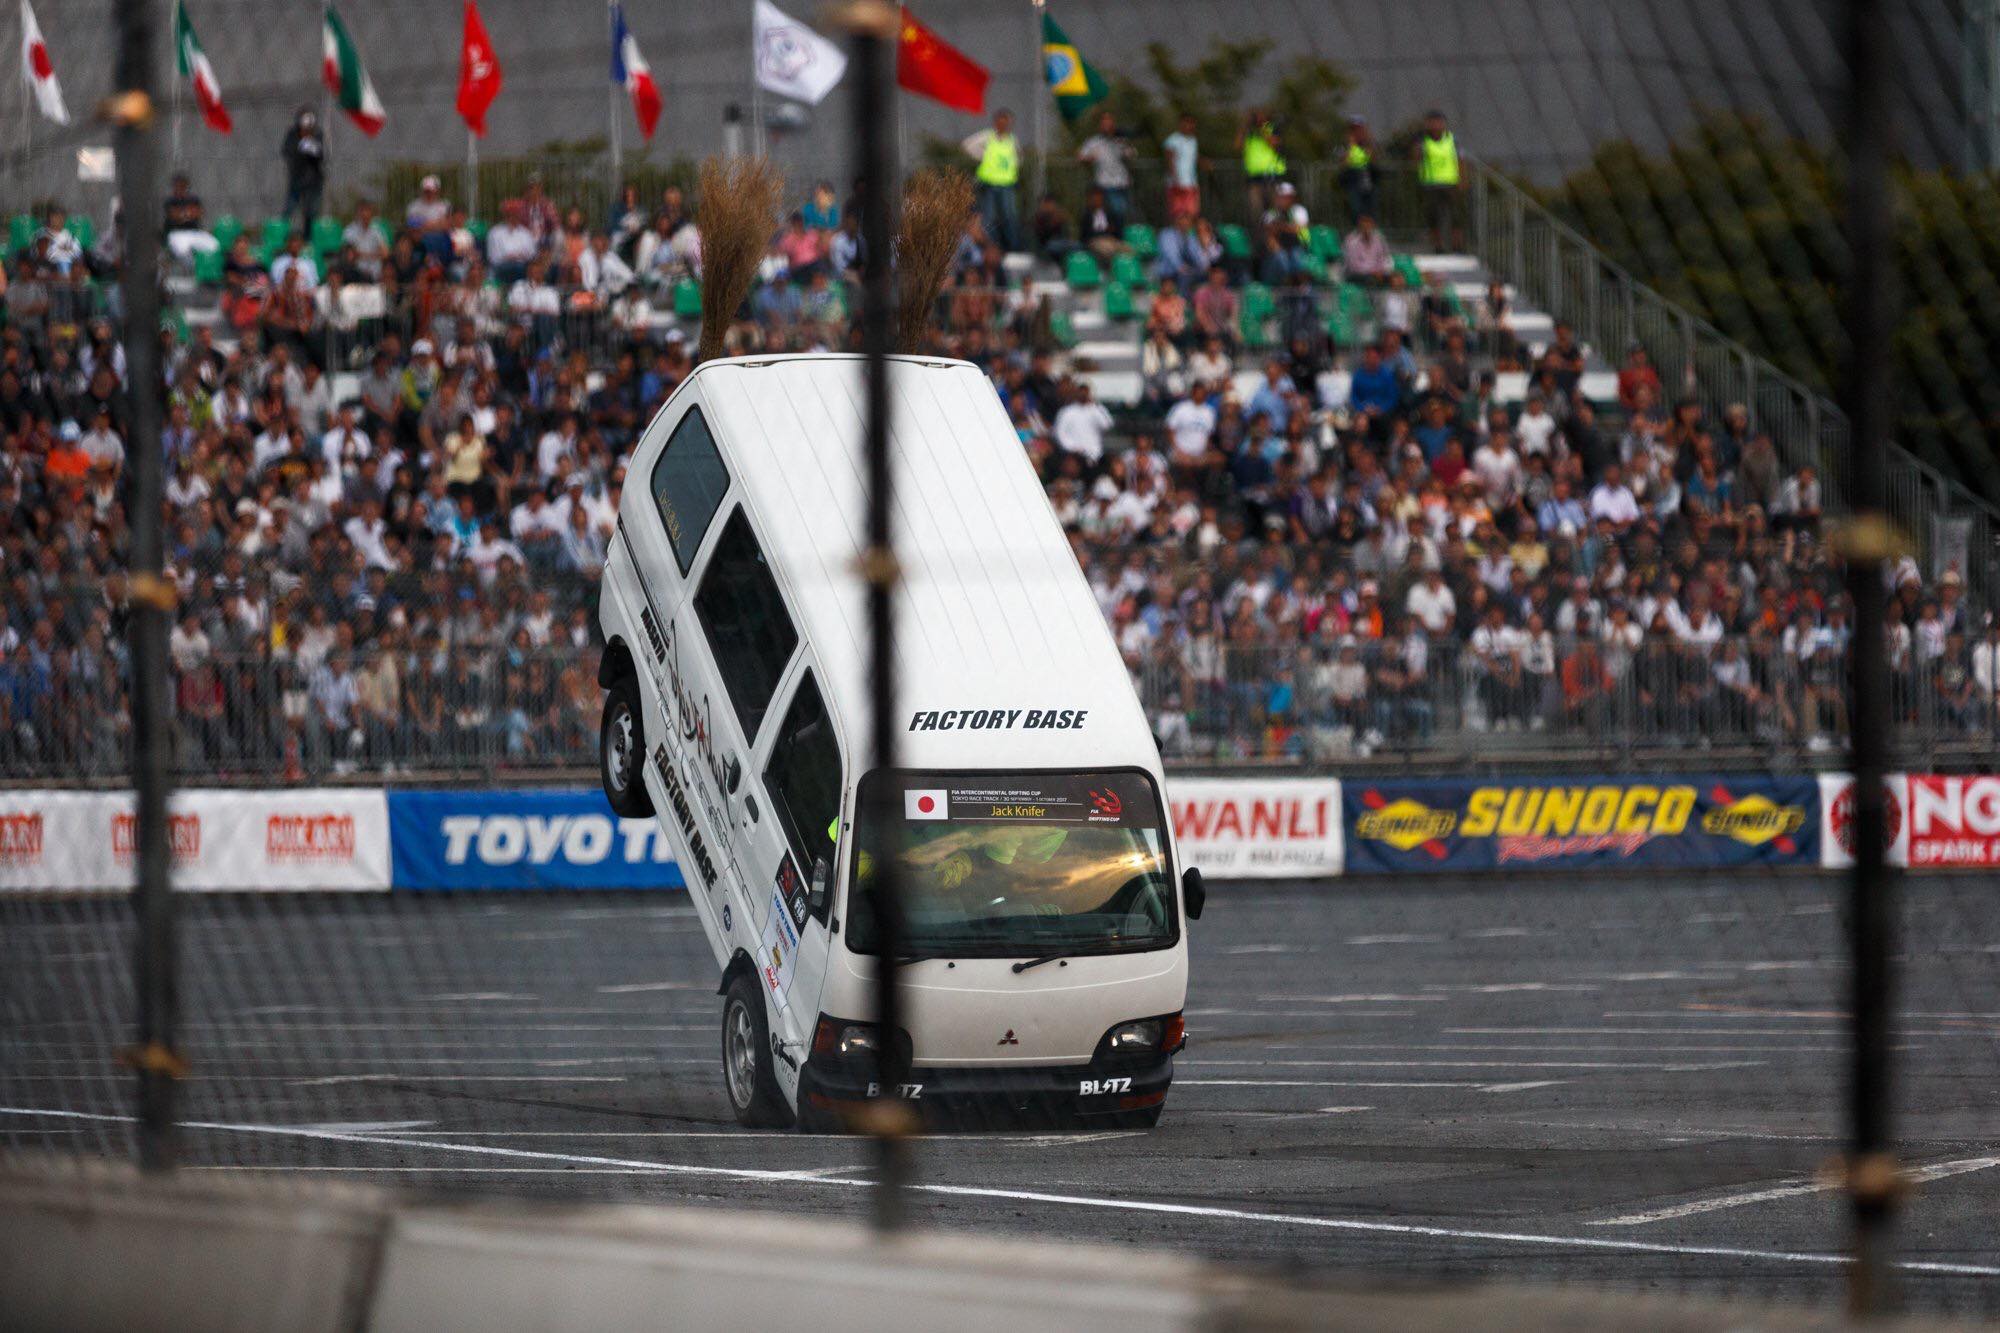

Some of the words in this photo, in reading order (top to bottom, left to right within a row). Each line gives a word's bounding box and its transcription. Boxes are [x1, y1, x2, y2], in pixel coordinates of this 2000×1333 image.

[908, 709, 1021, 732] FACTORY
[1022, 709, 1089, 730] BASE
[654, 742, 697, 837] FACTORY
[689, 829, 718, 893] BASE
[991, 805, 1012, 816] Jack
[1015, 805, 1046, 817] Knifer
[1170, 798, 1327, 840] WANLI
[1459, 784, 1698, 837] SUNOCO
[443, 814, 614, 865] TOYO
[1915, 840, 1986, 862] SPARK
[866, 1081, 923, 1099] BTZ
